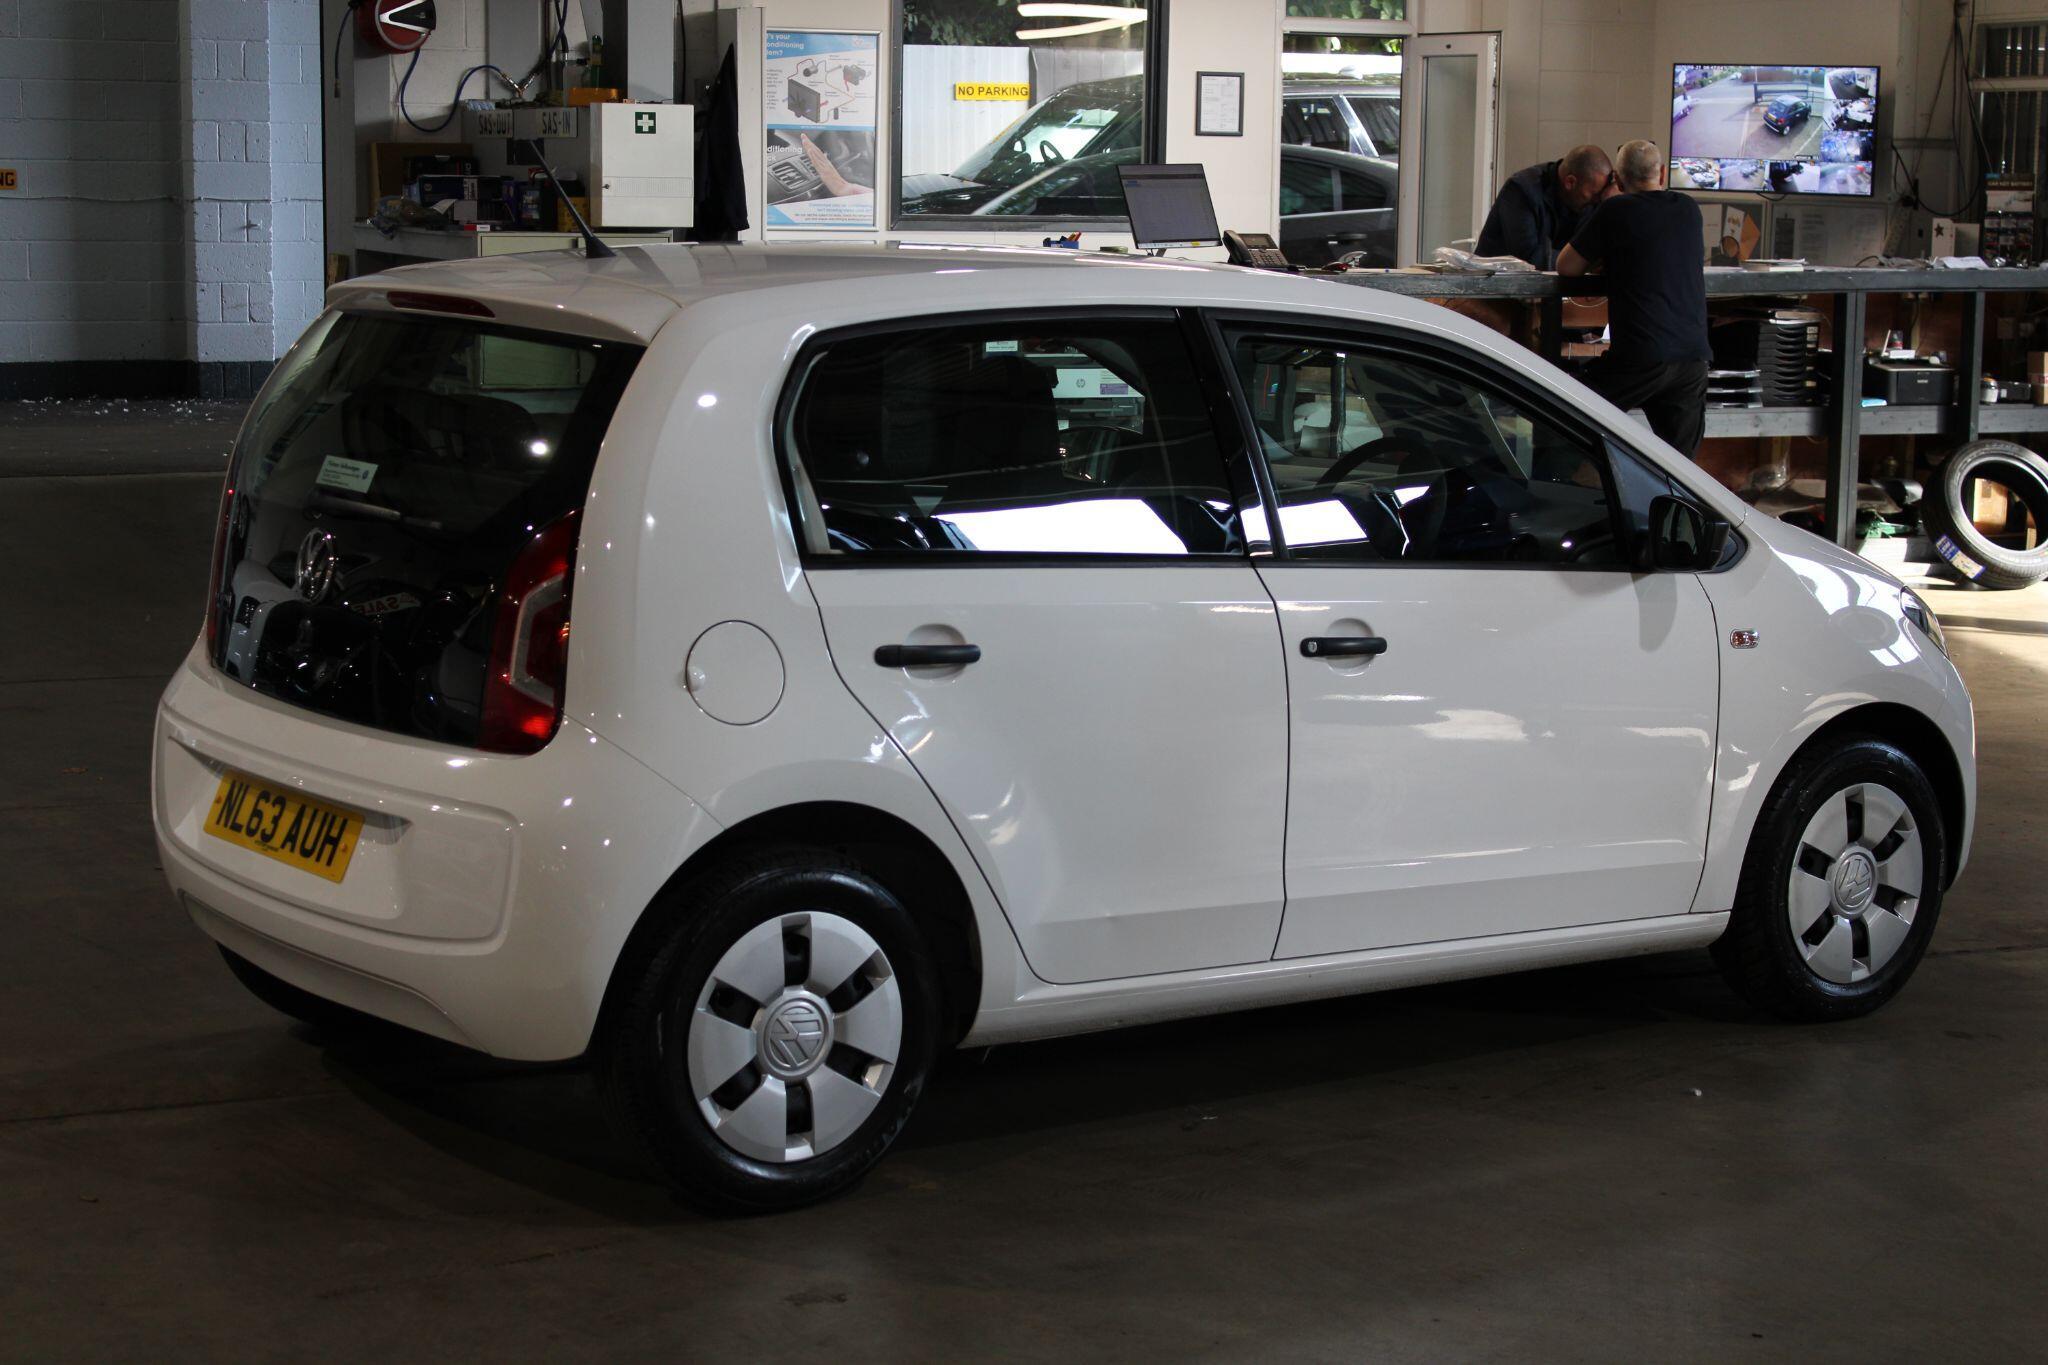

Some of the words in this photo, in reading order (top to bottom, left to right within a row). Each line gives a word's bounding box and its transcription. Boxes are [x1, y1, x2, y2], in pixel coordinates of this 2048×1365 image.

[958, 86, 975, 96] NO
[978, 86, 1029, 96] PARKING
[216, 779, 287, 844] NL63
[280, 804, 349, 867] AUH
